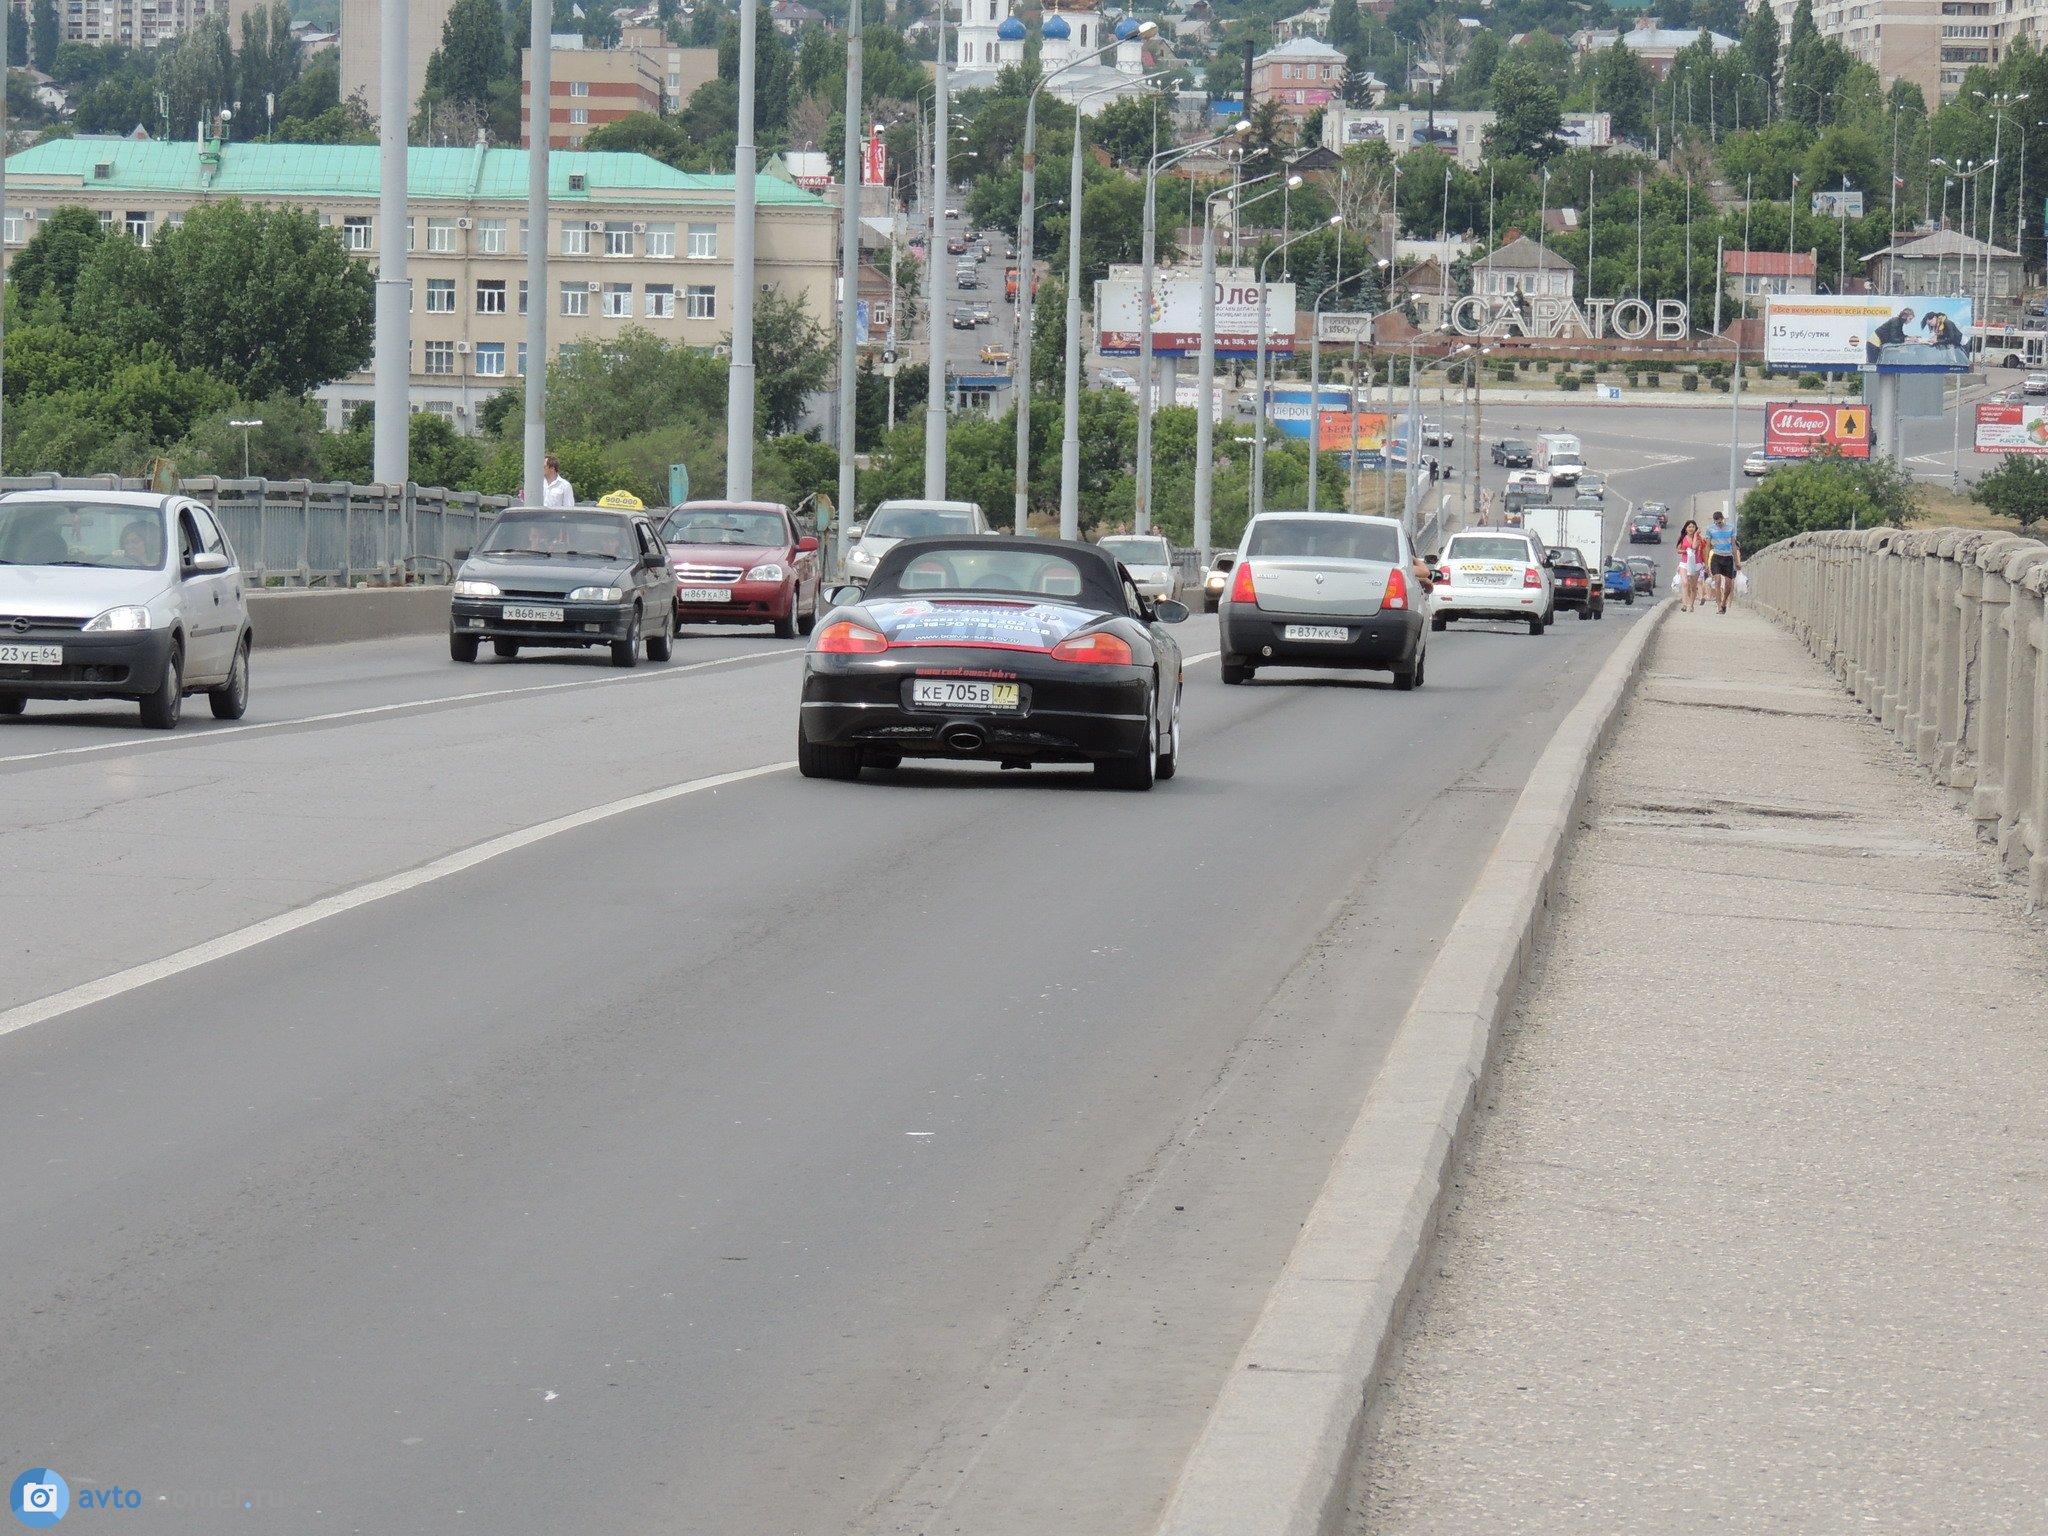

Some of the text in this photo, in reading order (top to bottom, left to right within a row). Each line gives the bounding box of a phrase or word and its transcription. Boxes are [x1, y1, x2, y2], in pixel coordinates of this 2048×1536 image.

[797, 177, 828, 186] УКОЙЛ
[1451, 295, 1687, 341] САРАТОВ
[1772, 326, 1830, 339] 15 руб/сутки
[1777, 414, 1824, 431] М.видео
[605, 496, 638, 505] 900-000
[42, 648, 57, 660] 64
[996, 685, 1012, 697] 77
